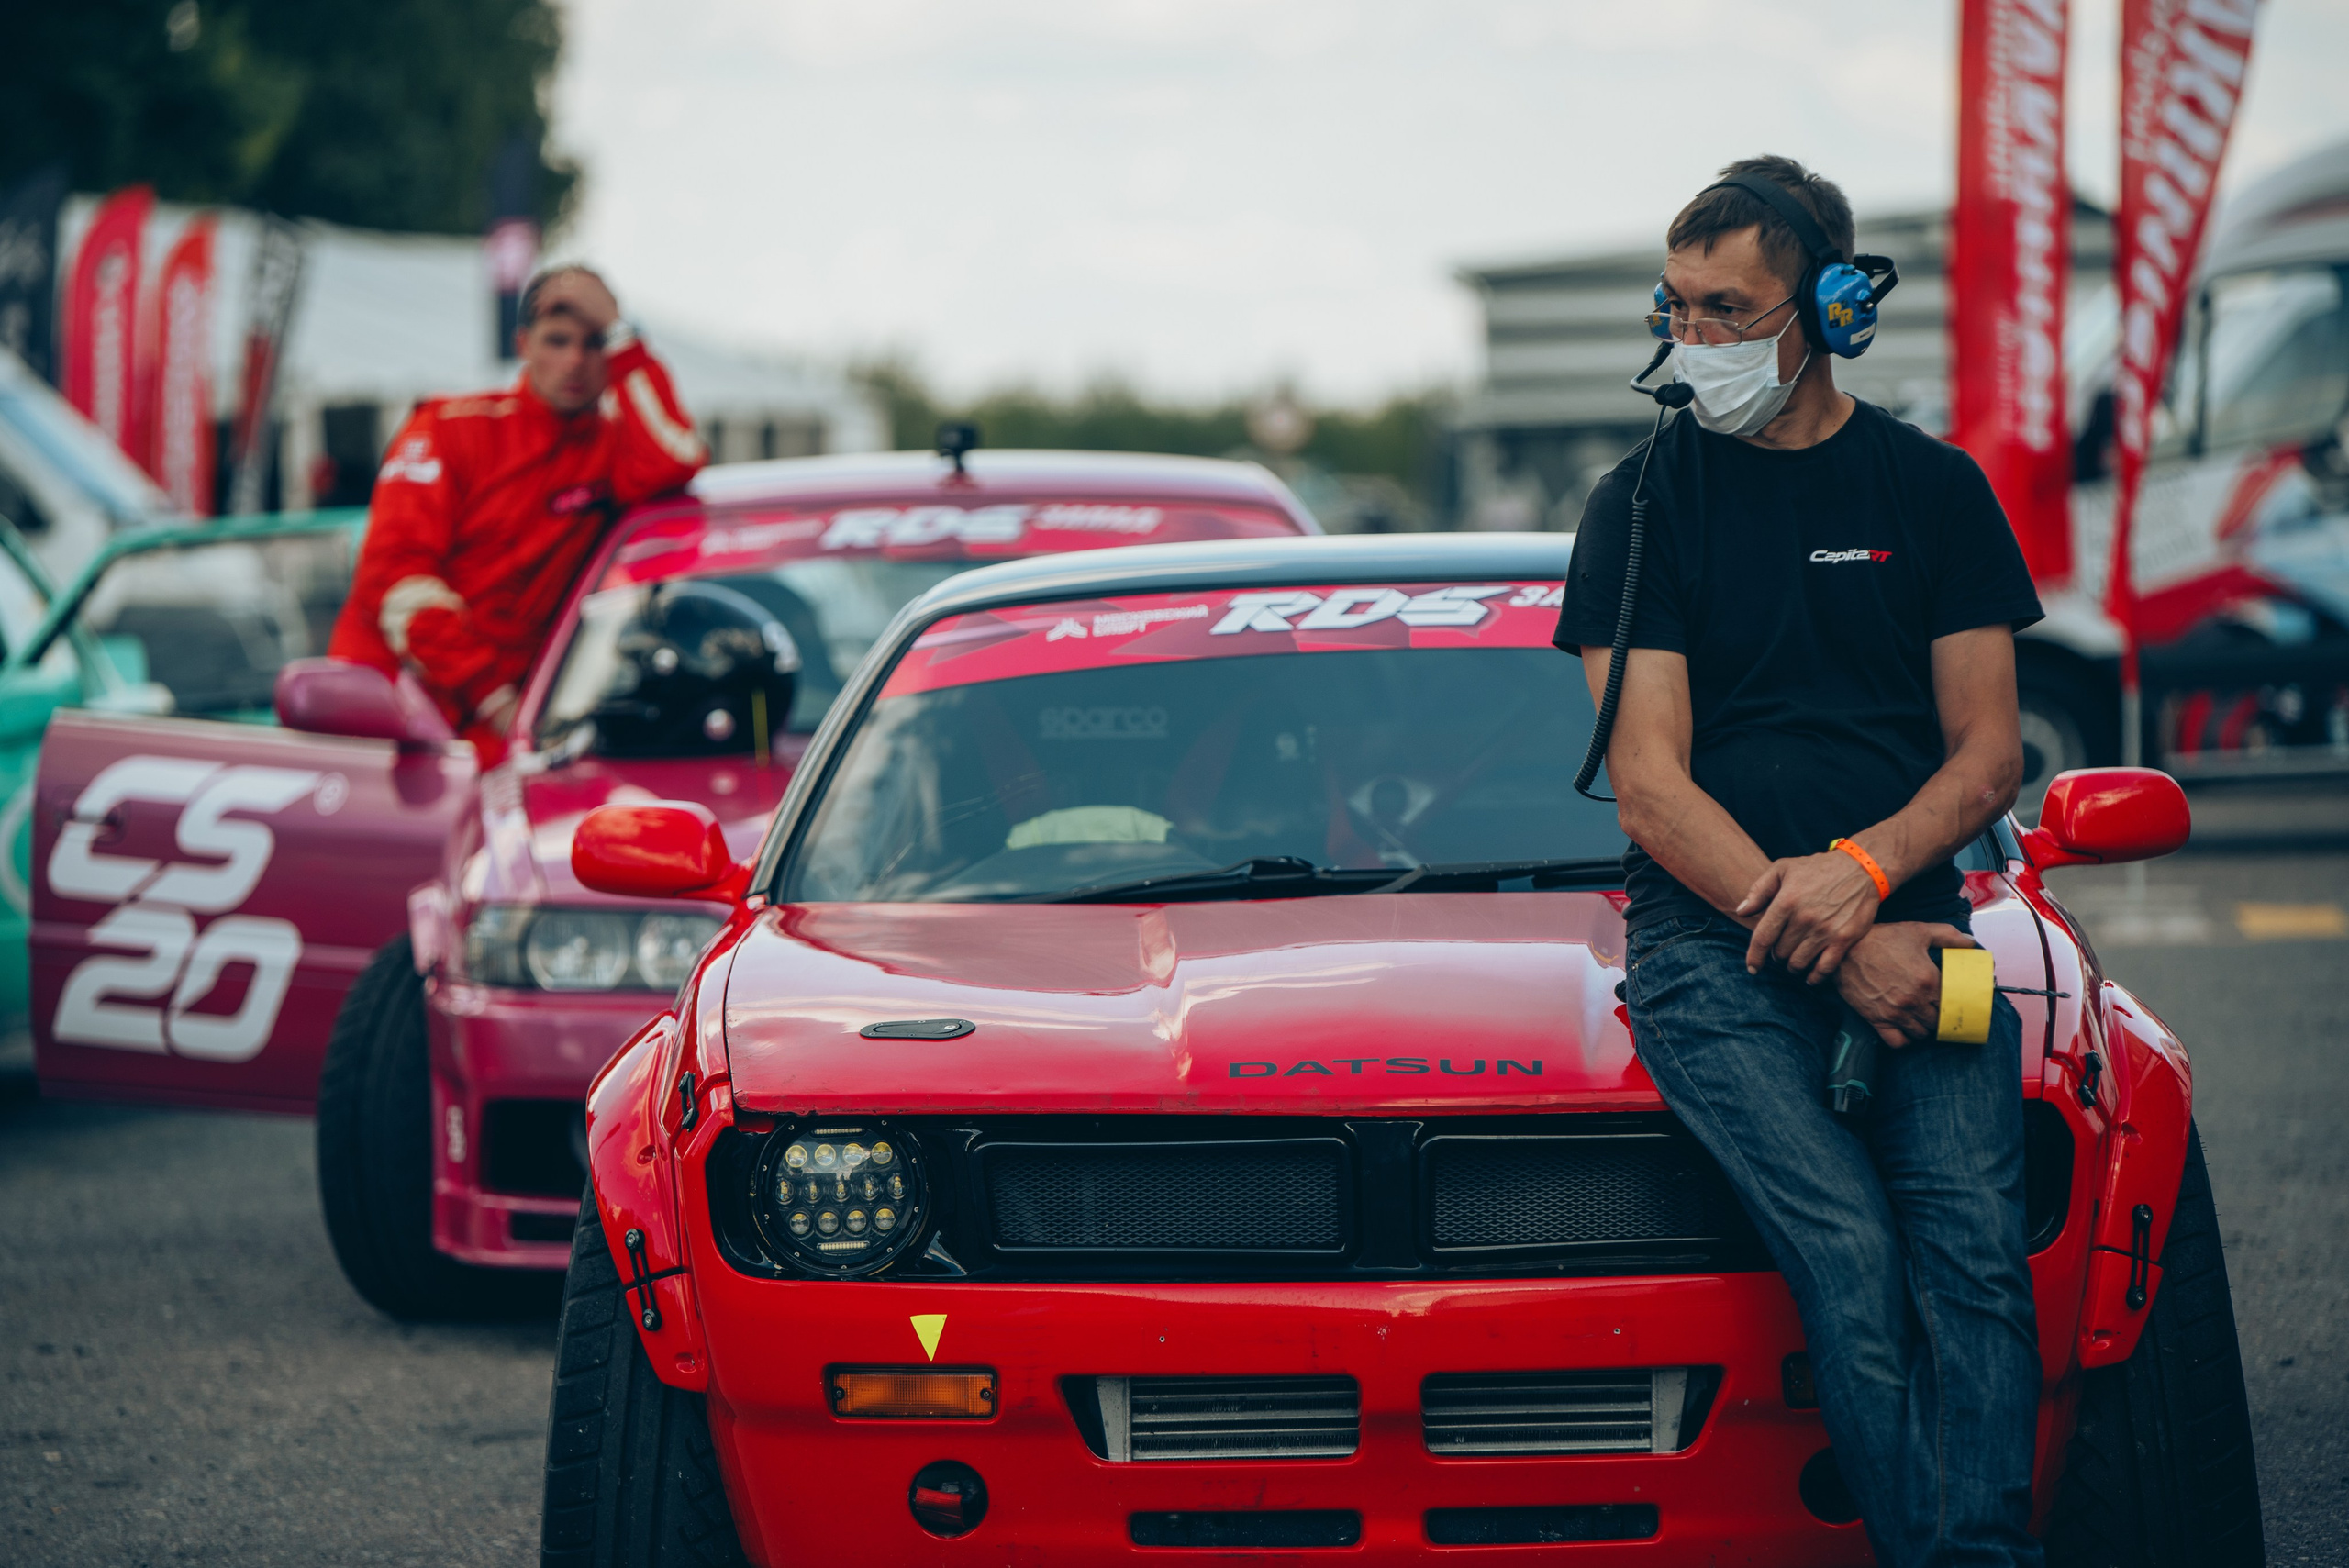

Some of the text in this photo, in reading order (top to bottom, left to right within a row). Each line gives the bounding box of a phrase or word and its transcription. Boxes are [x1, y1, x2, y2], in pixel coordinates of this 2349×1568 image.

[48, 754, 321, 913] CS
[52, 900, 303, 1064] 20
[1229, 1057, 1543, 1078] DATSUN
